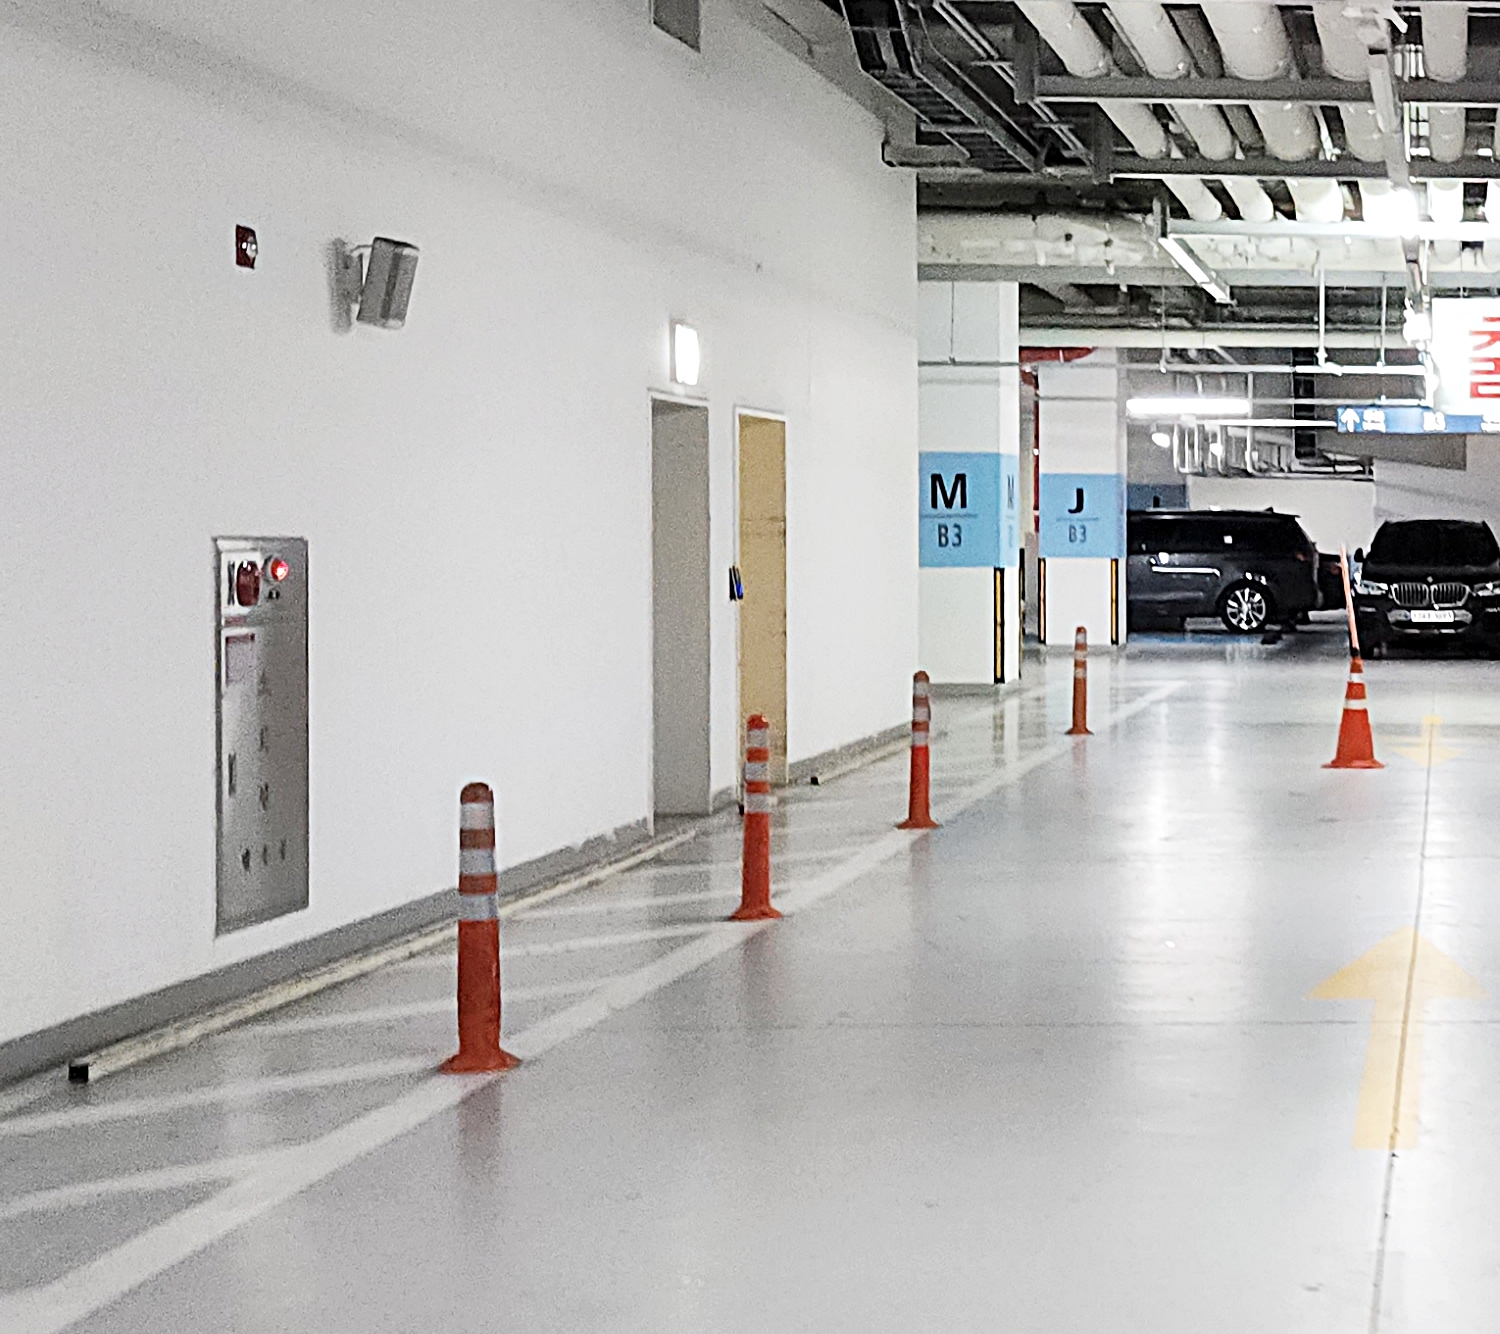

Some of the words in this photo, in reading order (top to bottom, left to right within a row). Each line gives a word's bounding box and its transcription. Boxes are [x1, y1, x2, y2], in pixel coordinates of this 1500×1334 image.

[930, 473, 967, 509] M
[1067, 487, 1085, 514] J
[937, 523, 963, 548] B3
[1068, 524, 1088, 544] B3
